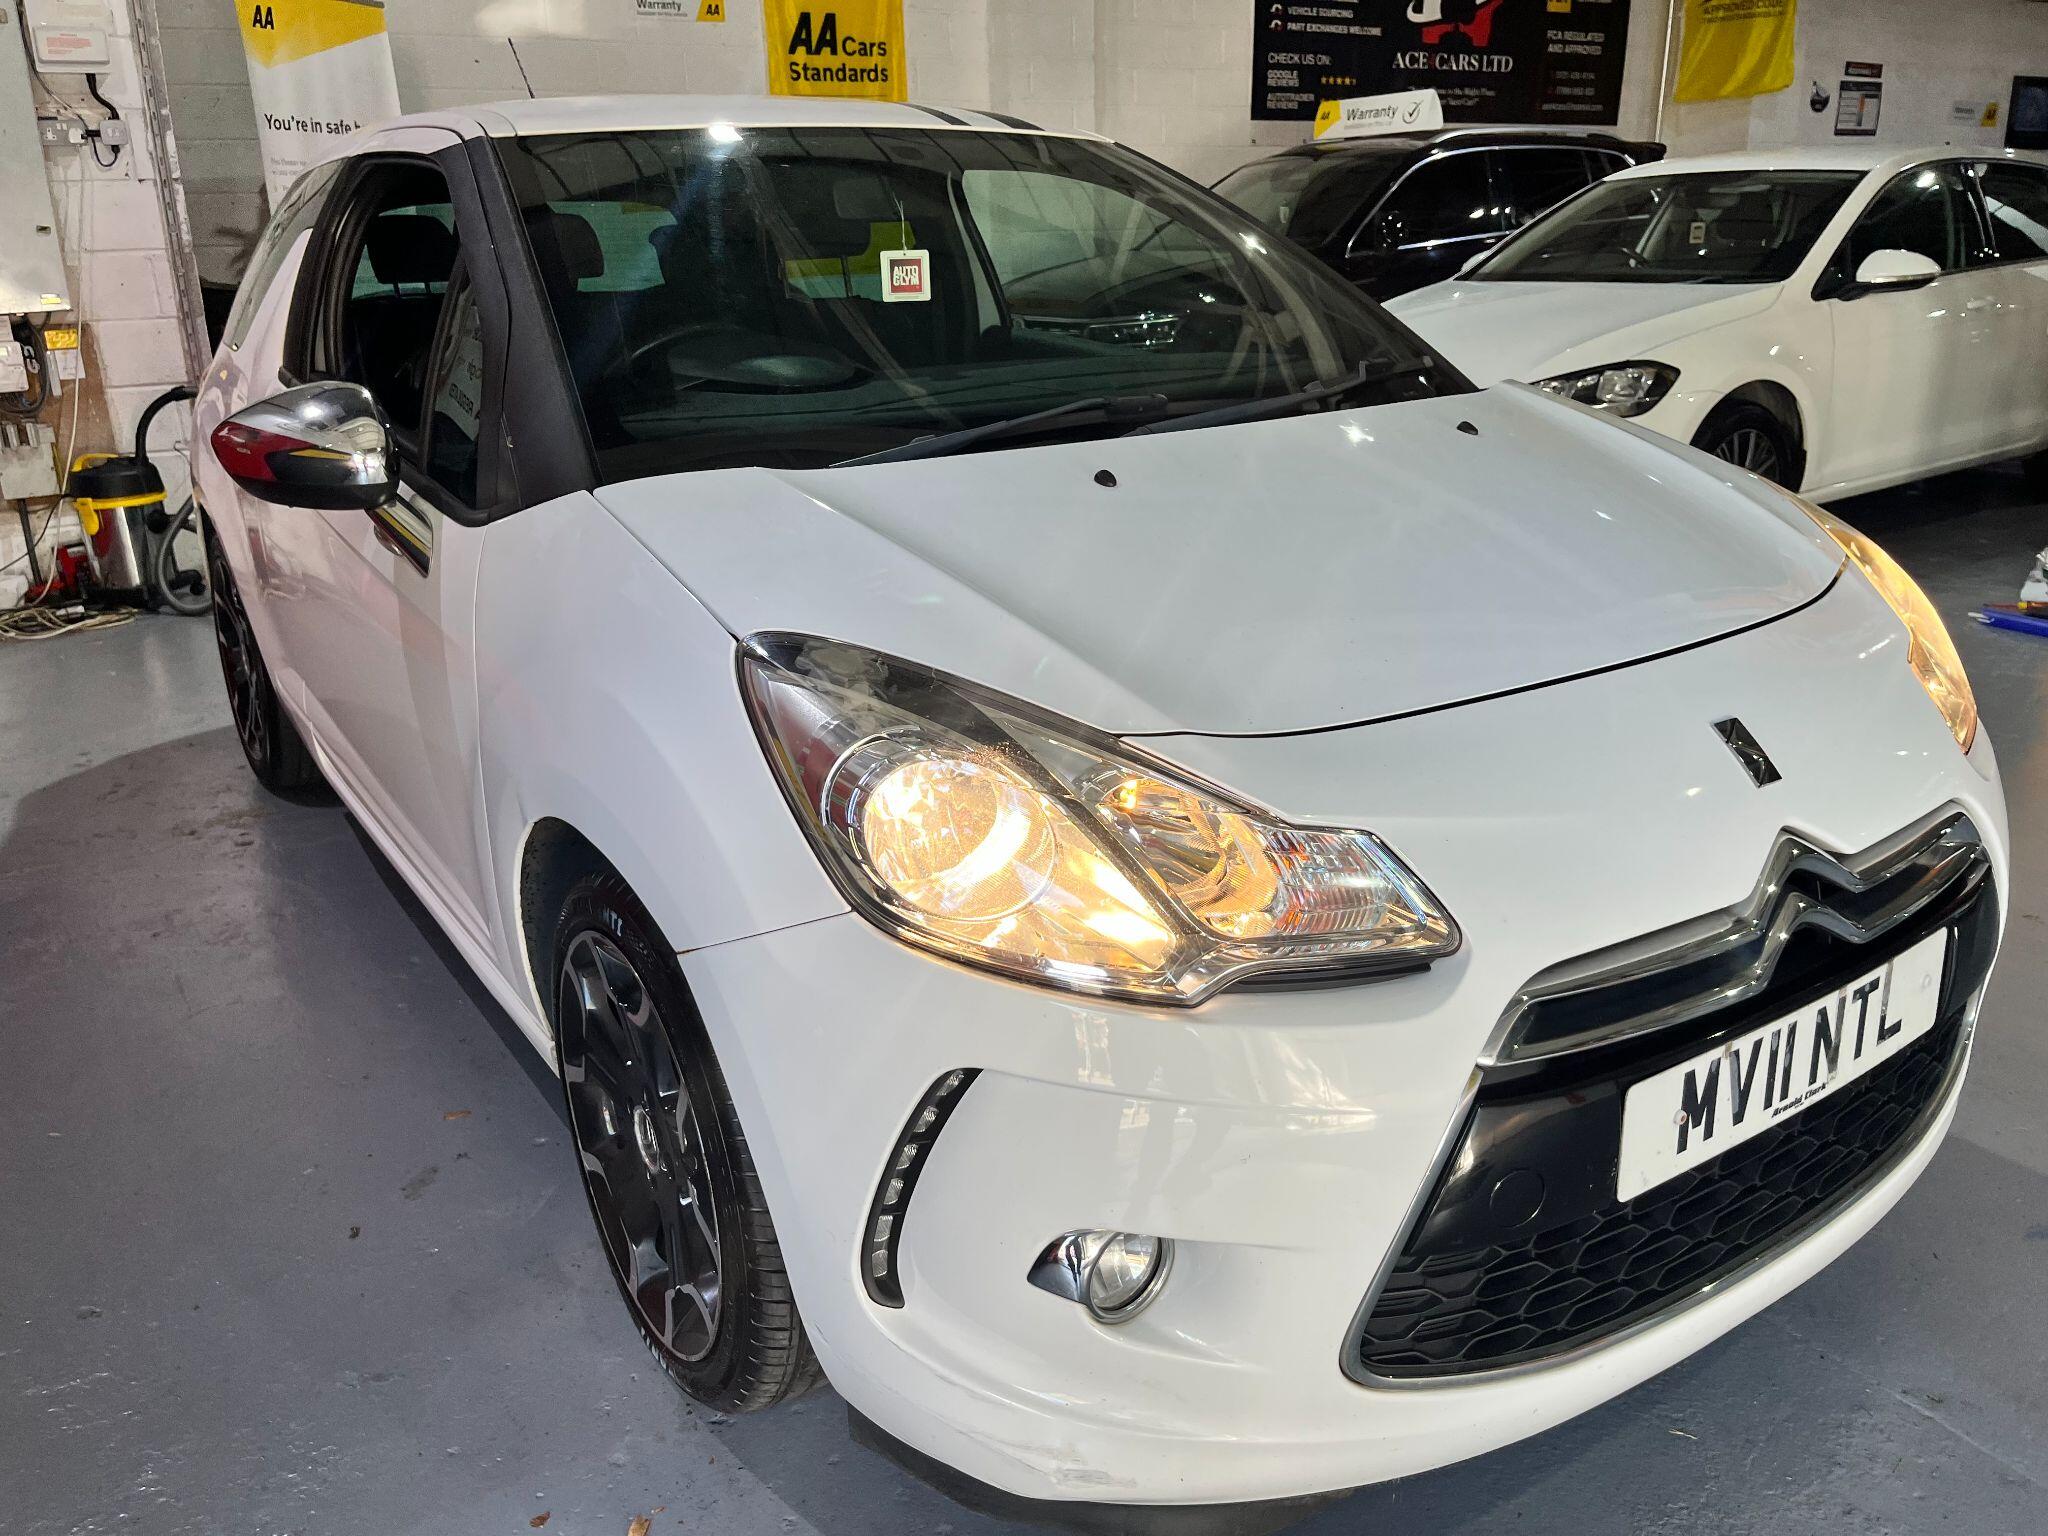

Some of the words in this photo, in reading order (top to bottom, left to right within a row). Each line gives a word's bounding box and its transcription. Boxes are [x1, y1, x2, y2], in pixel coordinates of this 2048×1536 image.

[252, 4, 275, 31] AA
[706, 4, 720, 16] AA
[1287, 7, 1318, 17] VEHICLE
[788, 11, 838, 56] AA
[842, 36, 887, 57] Cars
[1287, 22, 1305, 32] PART
[1267, 52, 1300, 64] CHECK
[1301, 53, 1315, 65] US
[1482, 55, 1514, 73] LTD
[789, 61, 889, 83] Standards
[1267, 70, 1298, 79] GOOGLE
[1346, 105, 1398, 121] Warranty
[264, 113, 309, 133] You're
[309, 116, 323, 134] in
[326, 119, 352, 135] safe
[893, 265, 919, 276] AUTO
[893, 275, 920, 287] GLYM
[1808, 960, 1903, 1088] NTL
[1771, 1093, 1804, 1119] Arnold
[1804, 1082, 1827, 1103] Clark
